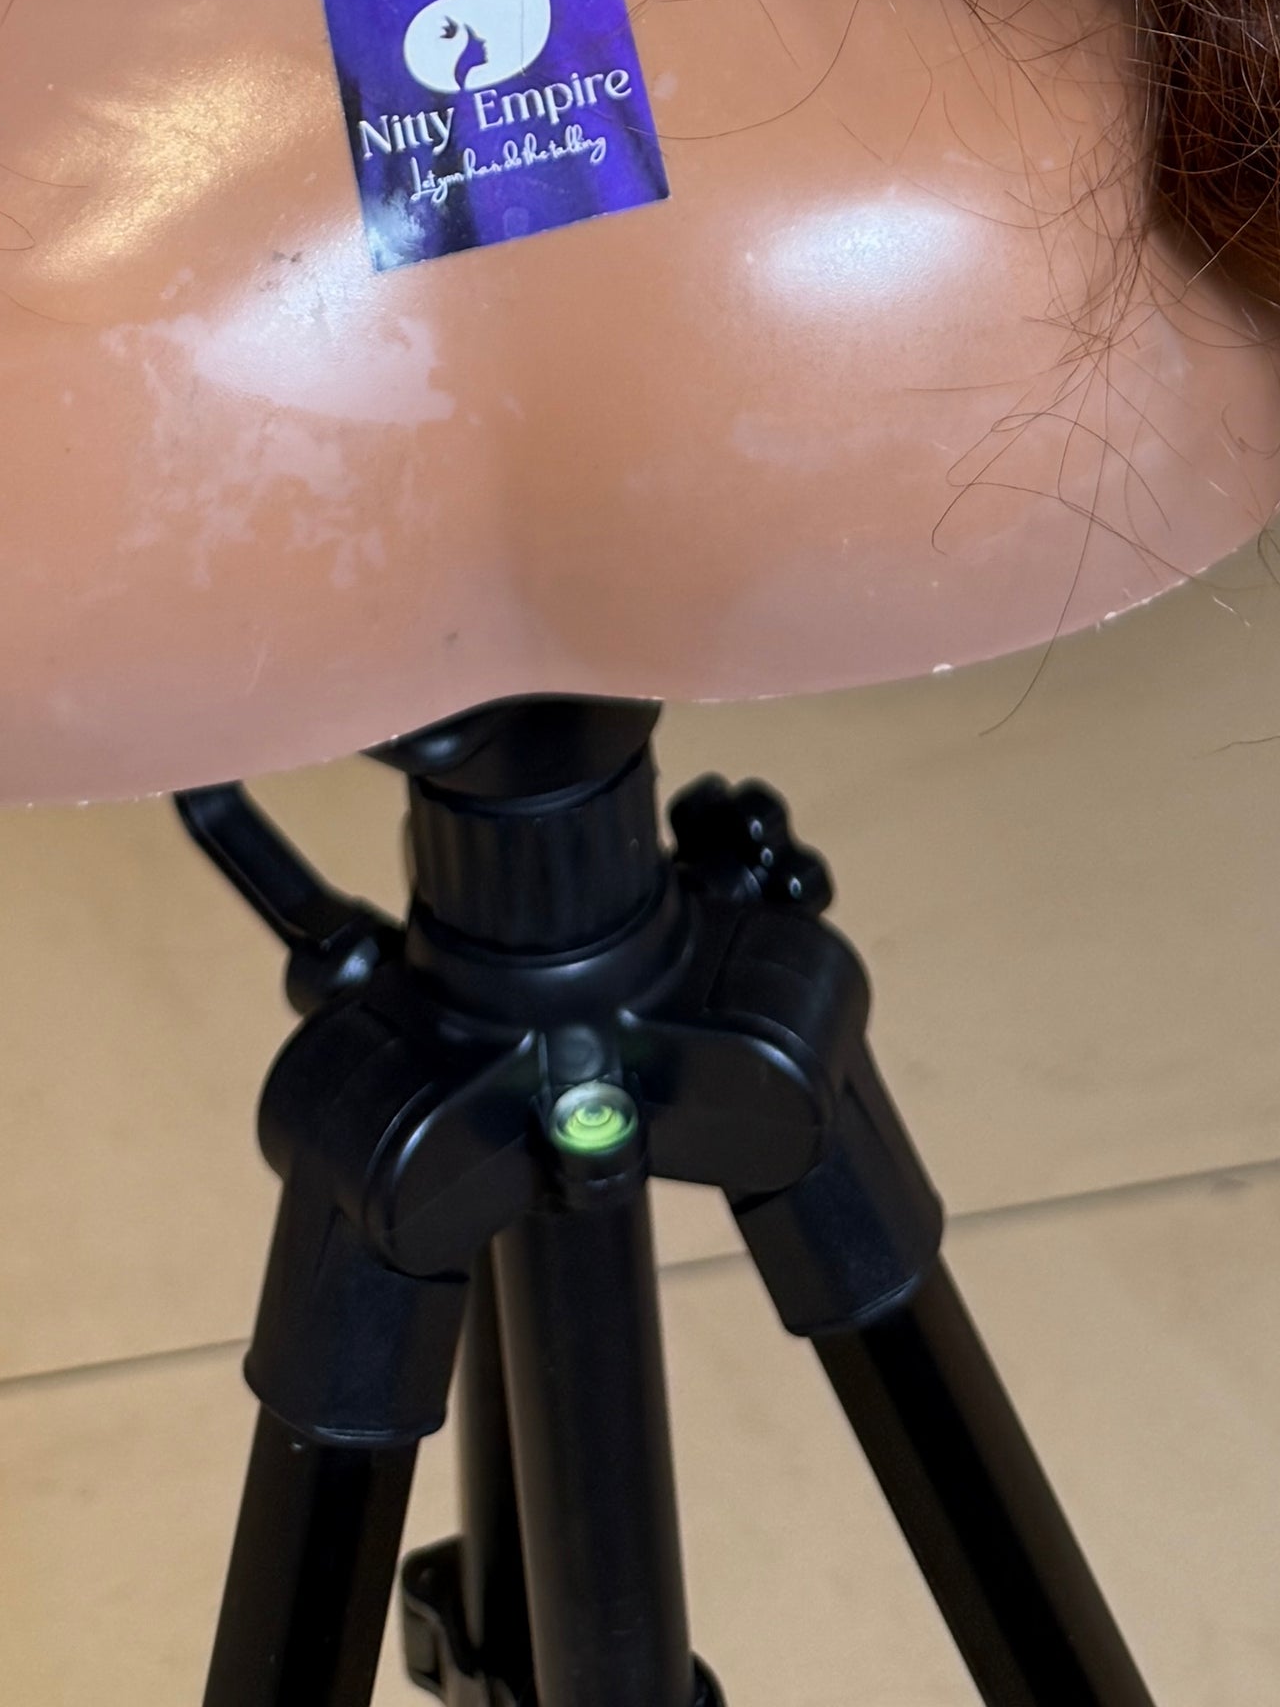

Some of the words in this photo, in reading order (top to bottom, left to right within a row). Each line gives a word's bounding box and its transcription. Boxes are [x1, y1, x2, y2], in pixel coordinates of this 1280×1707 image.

[359, 107, 454, 159] Nitty
[473, 68, 632, 130] Empire
[410, 157, 436, 202] Let
[463, 148, 501, 181] hair
[503, 140, 522, 170] do
[522, 133, 550, 165] the
[550, 124, 606, 164] talking
